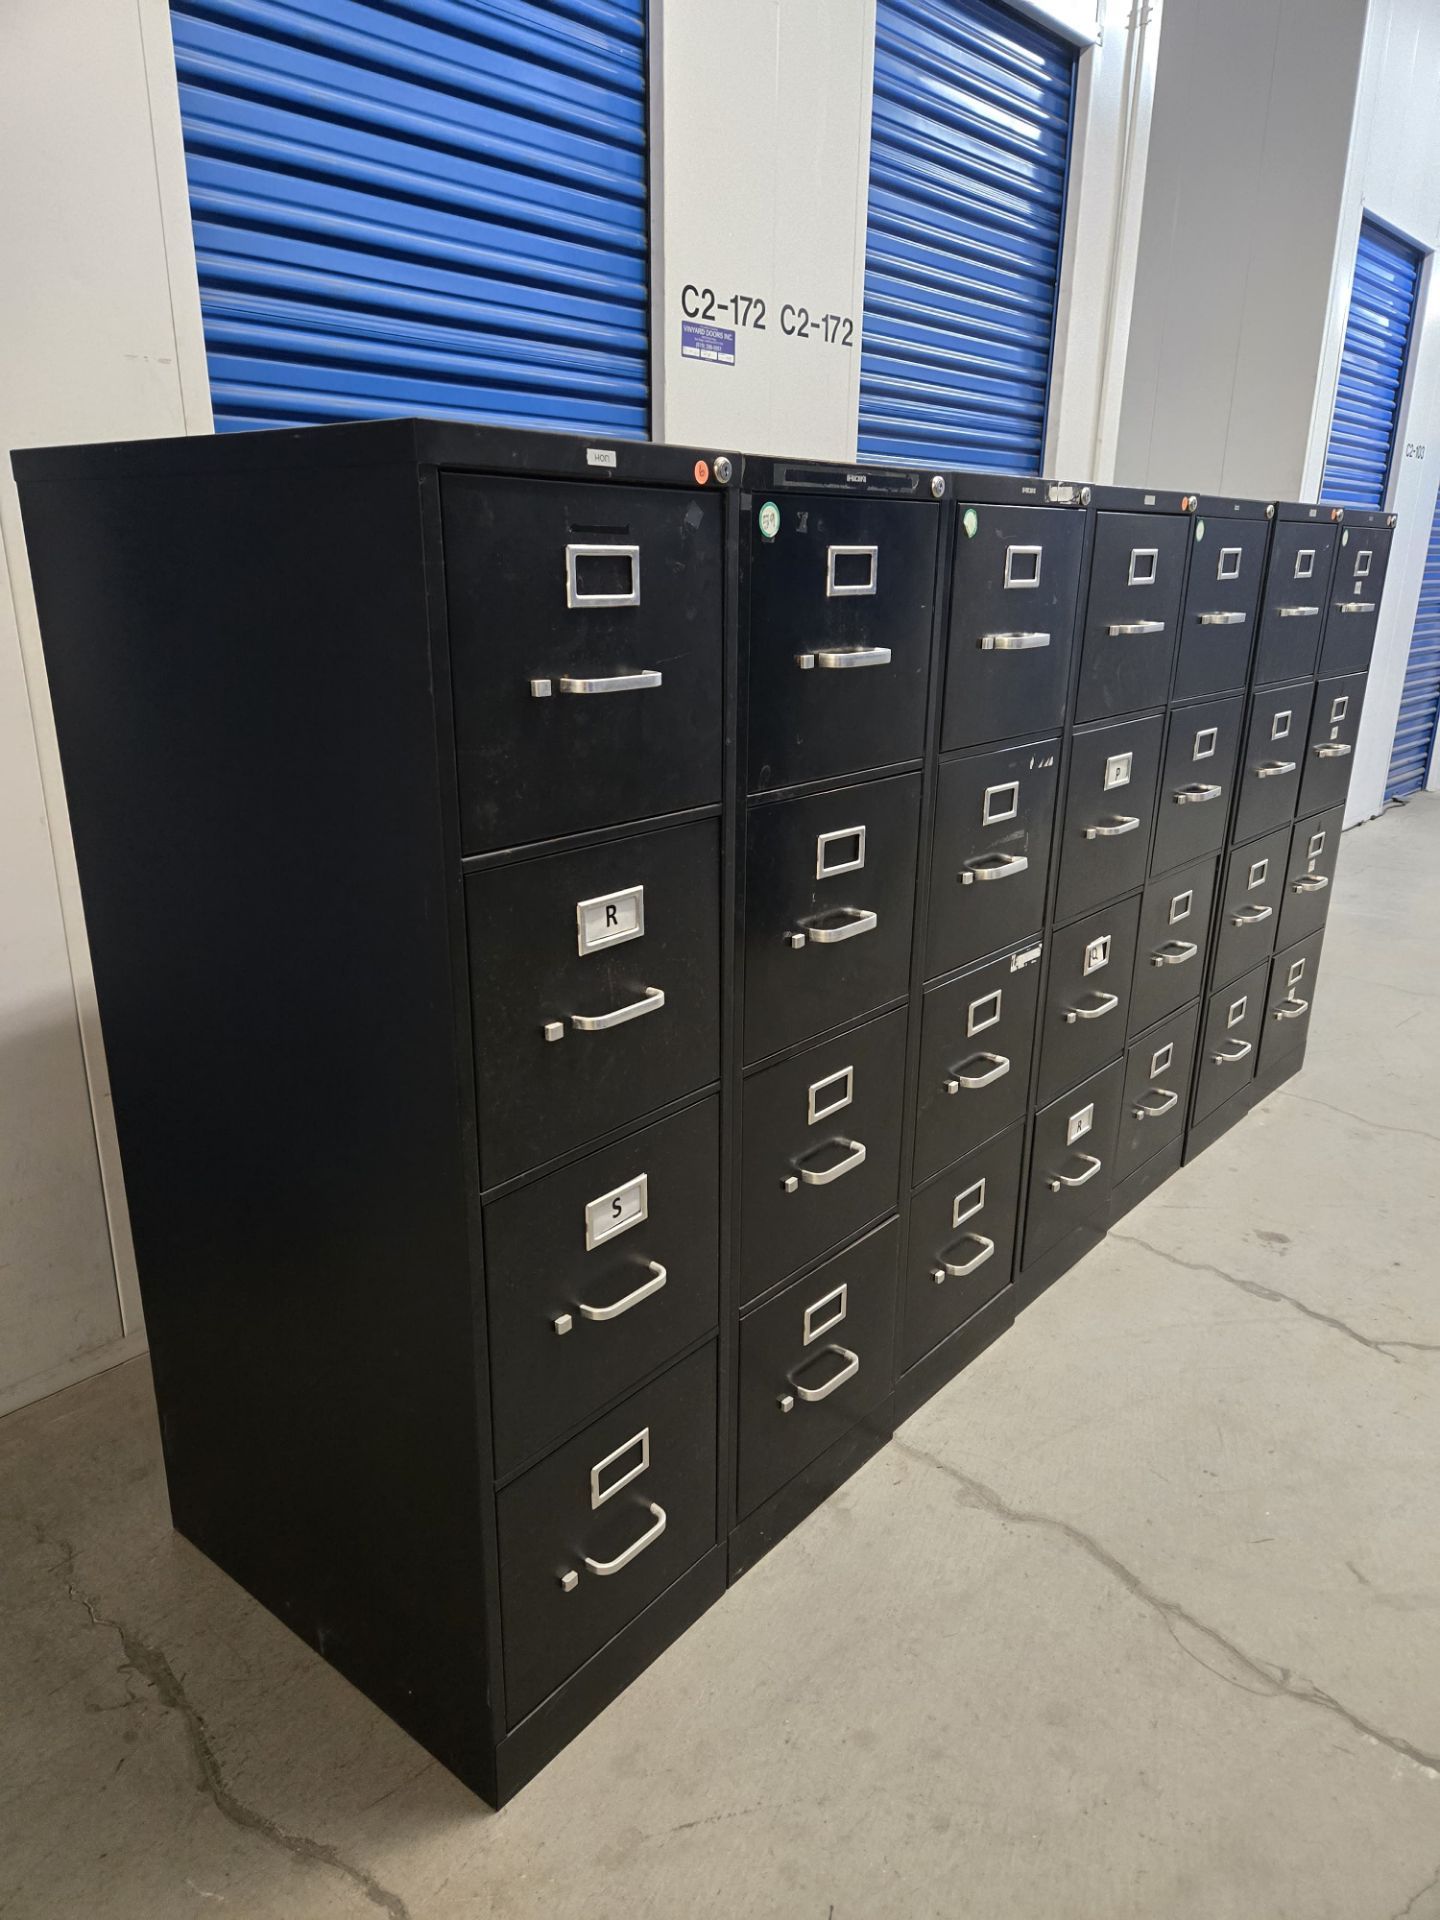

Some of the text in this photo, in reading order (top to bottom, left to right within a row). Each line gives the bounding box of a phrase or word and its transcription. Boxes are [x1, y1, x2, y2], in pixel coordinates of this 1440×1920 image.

[681, 284, 766, 330] C2-172
[683, 325, 705, 336] VINYARD
[780, 304, 853, 347] C2-172
[606, 904, 618, 928] R
[612, 1197, 622, 1219] S
